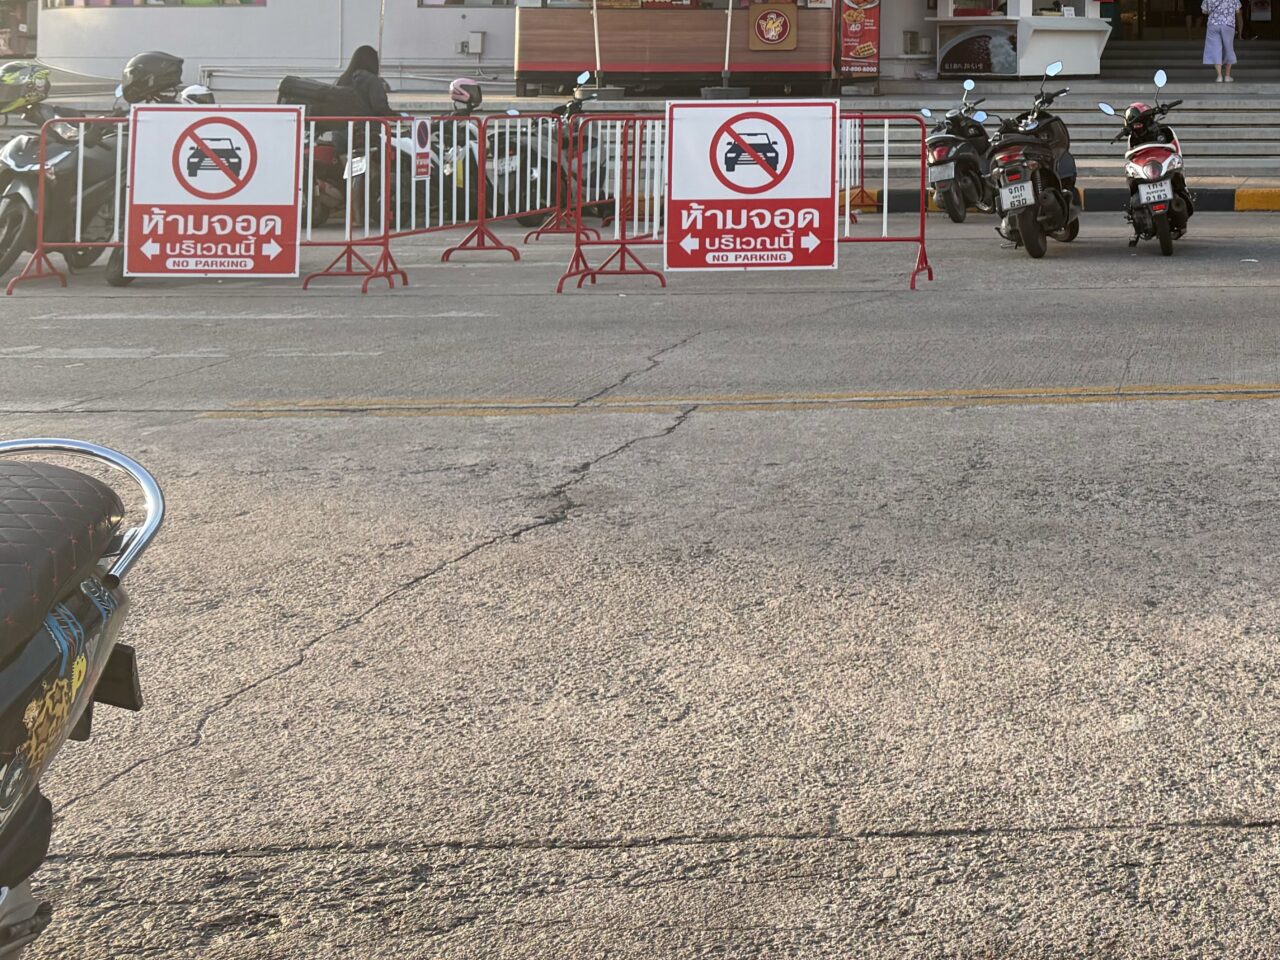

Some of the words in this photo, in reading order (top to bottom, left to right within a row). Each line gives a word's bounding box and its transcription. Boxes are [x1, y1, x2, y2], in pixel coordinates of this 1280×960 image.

[142, 207, 282, 236] ห้ามจอด
[681, 202, 820, 231] ห้ามจอด
[165, 236, 257, 256] บริเวณนี้
[705, 229, 795, 250] บริเวณนี้
[172, 260, 189, 268] NO
[195, 260, 247, 269] PARKING
[712, 254, 729, 262] NO
[735, 253, 787, 262] PARKING
